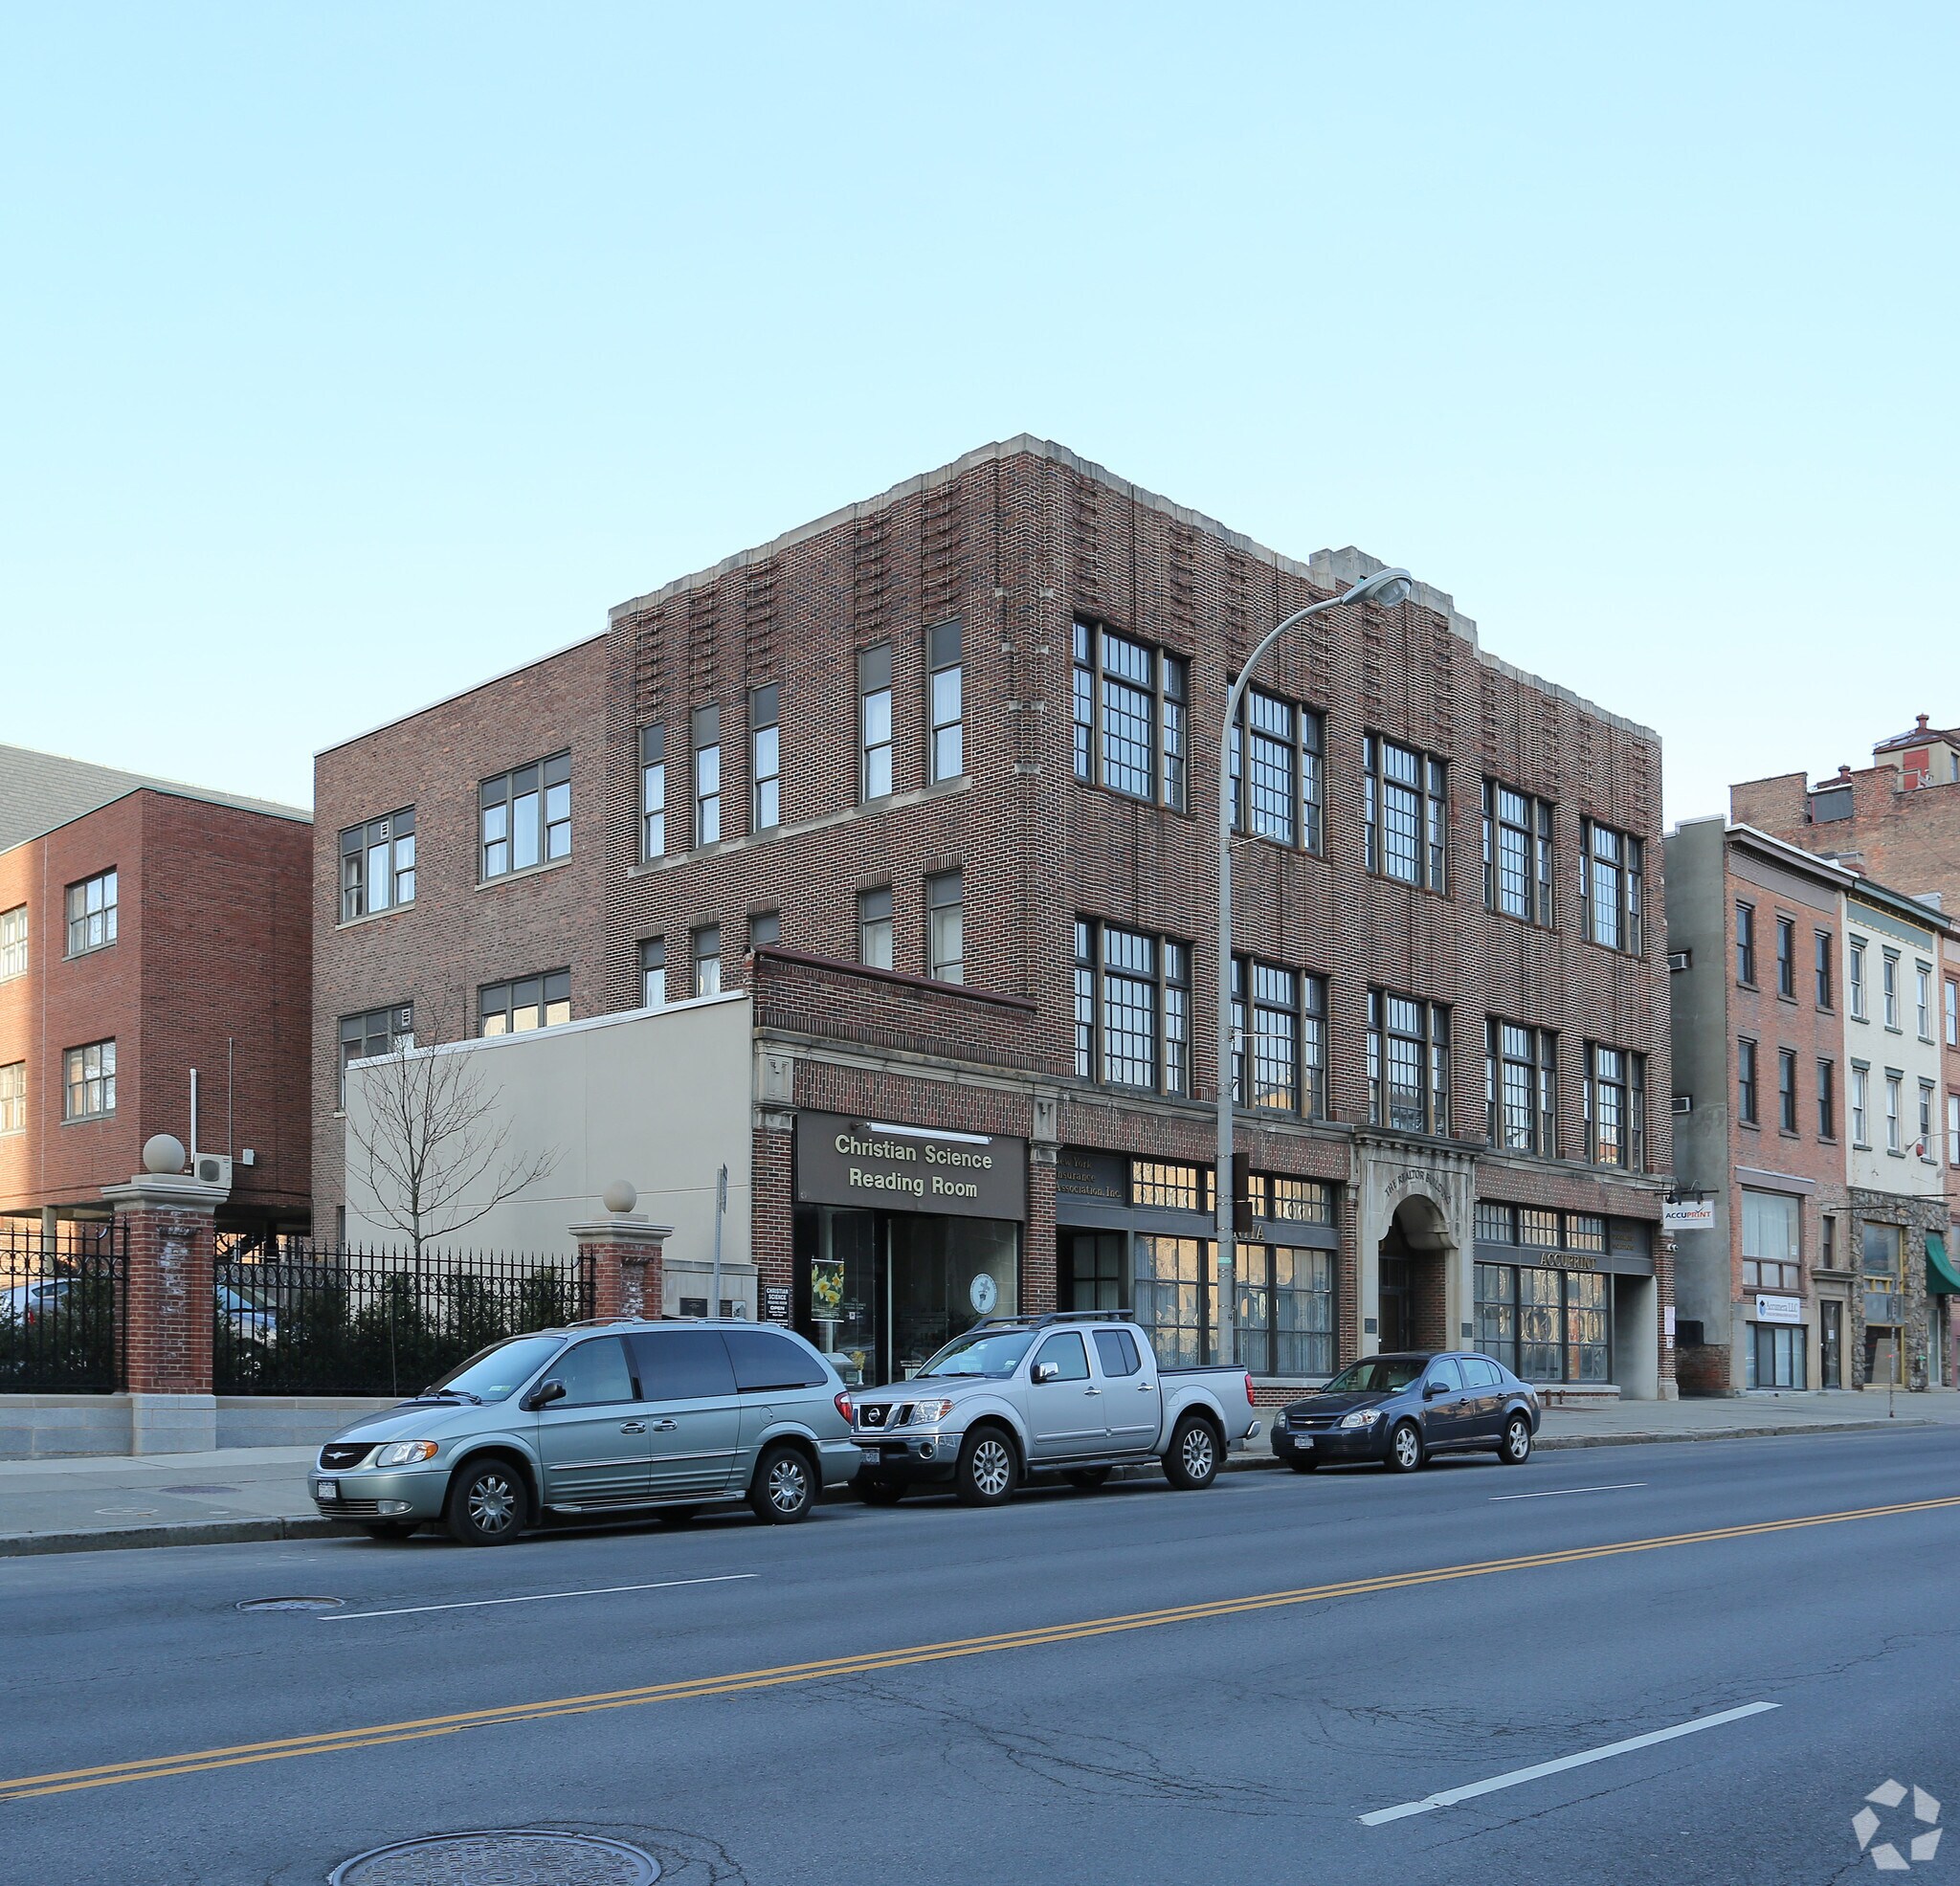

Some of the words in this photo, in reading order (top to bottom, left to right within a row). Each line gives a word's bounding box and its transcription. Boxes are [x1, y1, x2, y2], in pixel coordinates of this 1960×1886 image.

[835, 1134, 917, 1162] Christian
[924, 1144, 992, 1169] Science
[1073, 1156, 1092, 1169] York
[849, 1167, 924, 1197] Reading
[931, 1176, 978, 1198] Room
[1057, 1171, 1097, 1183] nsurance
[1384, 1179, 1397, 1197] THE
[1397, 1169, 1425, 1185] REALTOR
[1106, 1187, 1122, 1198] Inc.
[1665, 1209, 1711, 1219] ACCUPRINT
[1540, 1252, 1596, 1270] ACCUPRINT
